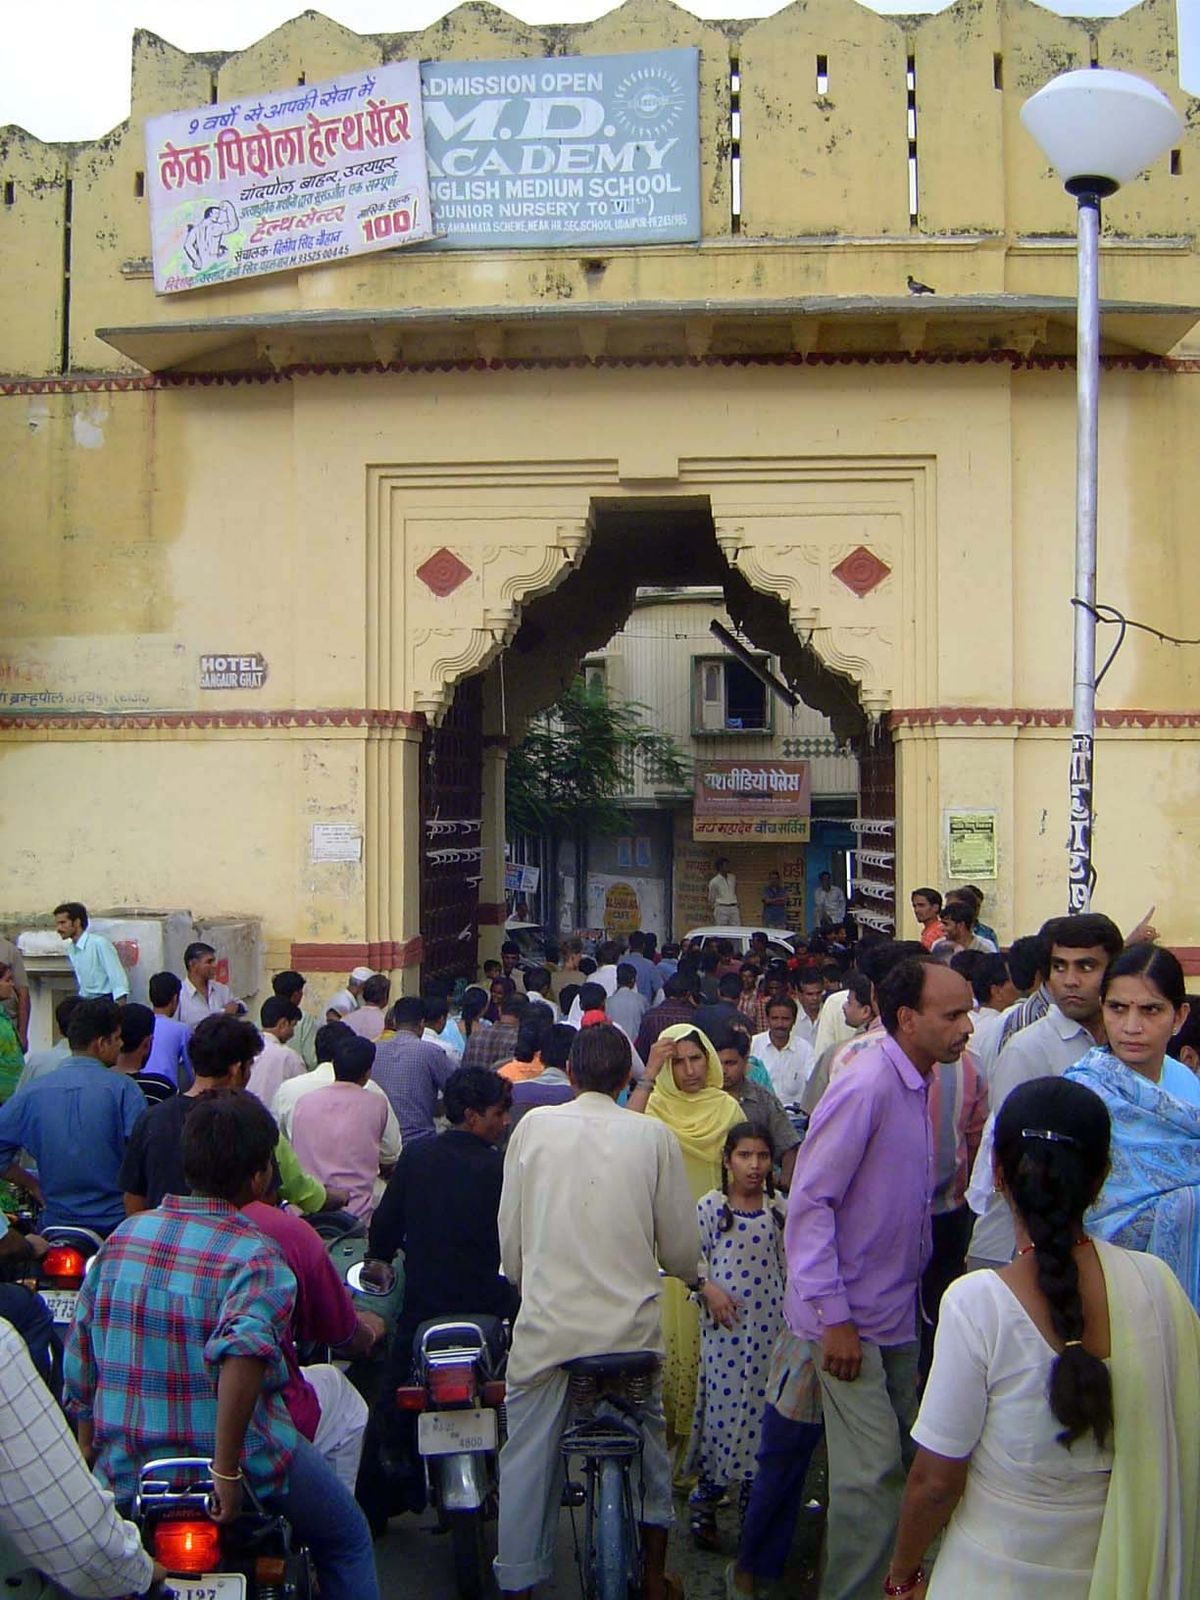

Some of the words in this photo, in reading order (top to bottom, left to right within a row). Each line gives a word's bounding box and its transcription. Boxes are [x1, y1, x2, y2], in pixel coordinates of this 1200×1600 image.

[541, 72, 603, 93] OPEN
[188, 118, 199, 134] 9
[244, 103, 261, 122] से
[263, 88, 318, 119] आपकी
[320, 84, 354, 108] सेवा
[355, 76, 376, 97] में
[158, 142, 212, 190] लेक
[214, 123, 305, 181] पिछोला
[307, 113, 366, 167] हेल्थ
[366, 99, 413, 149] सेंटर
[240, 176, 297, 201] चांदपोल
[343, 155, 398, 178] उदयपुर
[505, 177, 583, 200] MEDIUM
[588, 172, 681, 196] SCHOOL
[435, 202, 494, 220] JUNIOR
[499, 201, 580, 218] NURSERY
[587, 201, 608, 217] TO
[201, 657, 263, 672] HOTEL
[239, 671, 263, 687] GHAT
